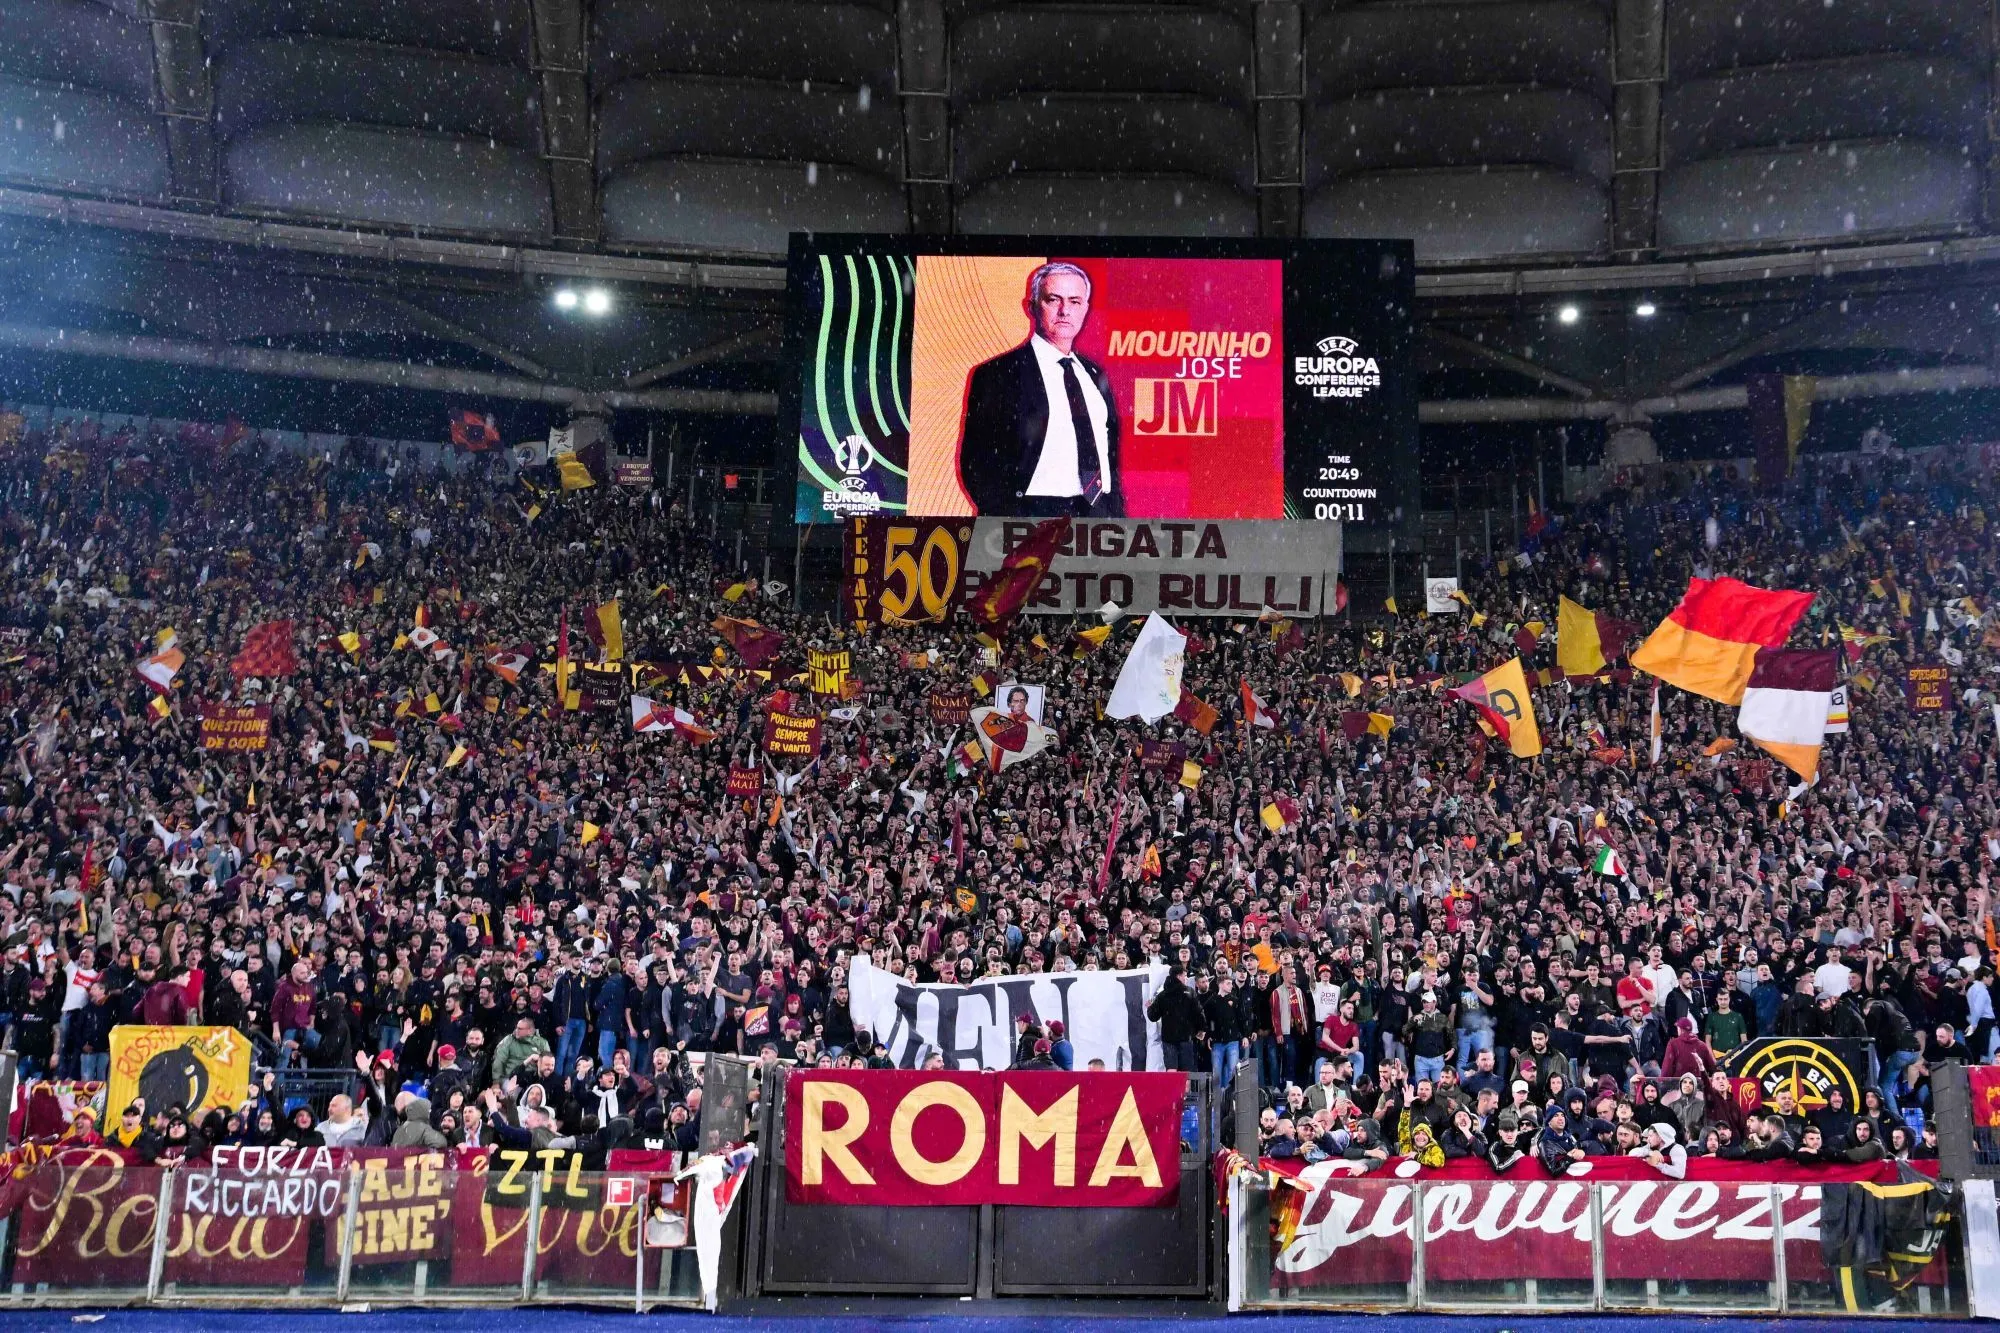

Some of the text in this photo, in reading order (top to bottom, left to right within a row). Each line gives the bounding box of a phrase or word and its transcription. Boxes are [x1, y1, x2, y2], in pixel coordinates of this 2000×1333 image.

[1108, 330, 1272, 358] MOURINHO
[1318, 339, 1356, 354] UEFA
[1175, 352, 1243, 378] JOSÉ
[1295, 356, 1380, 374] EUROPA
[1295, 375, 1381, 386] CONFERENCE
[1136, 380, 1215, 434] JM
[1328, 455, 1351, 464] TIME
[1319, 467, 1360, 480] 20:49
[823, 491, 881, 503] EUROPA
[1303, 488, 1377, 498] COUNTDOWN
[1158, 573, 1313, 612] RULLI
[932, 694, 969, 707] ROMA
[202, 719, 268, 732] QUESTIONE
[770, 712, 816, 729] PORTEREMO
[775, 728, 809, 741] SEMPRE
[783, 743, 811, 753] VANTO
[730, 780, 760, 789] MALE
[801, 1080, 1164, 1188] ROMA
[211, 1145, 333, 1178] FORZA
[497, 1149, 589, 1198] ZTL
